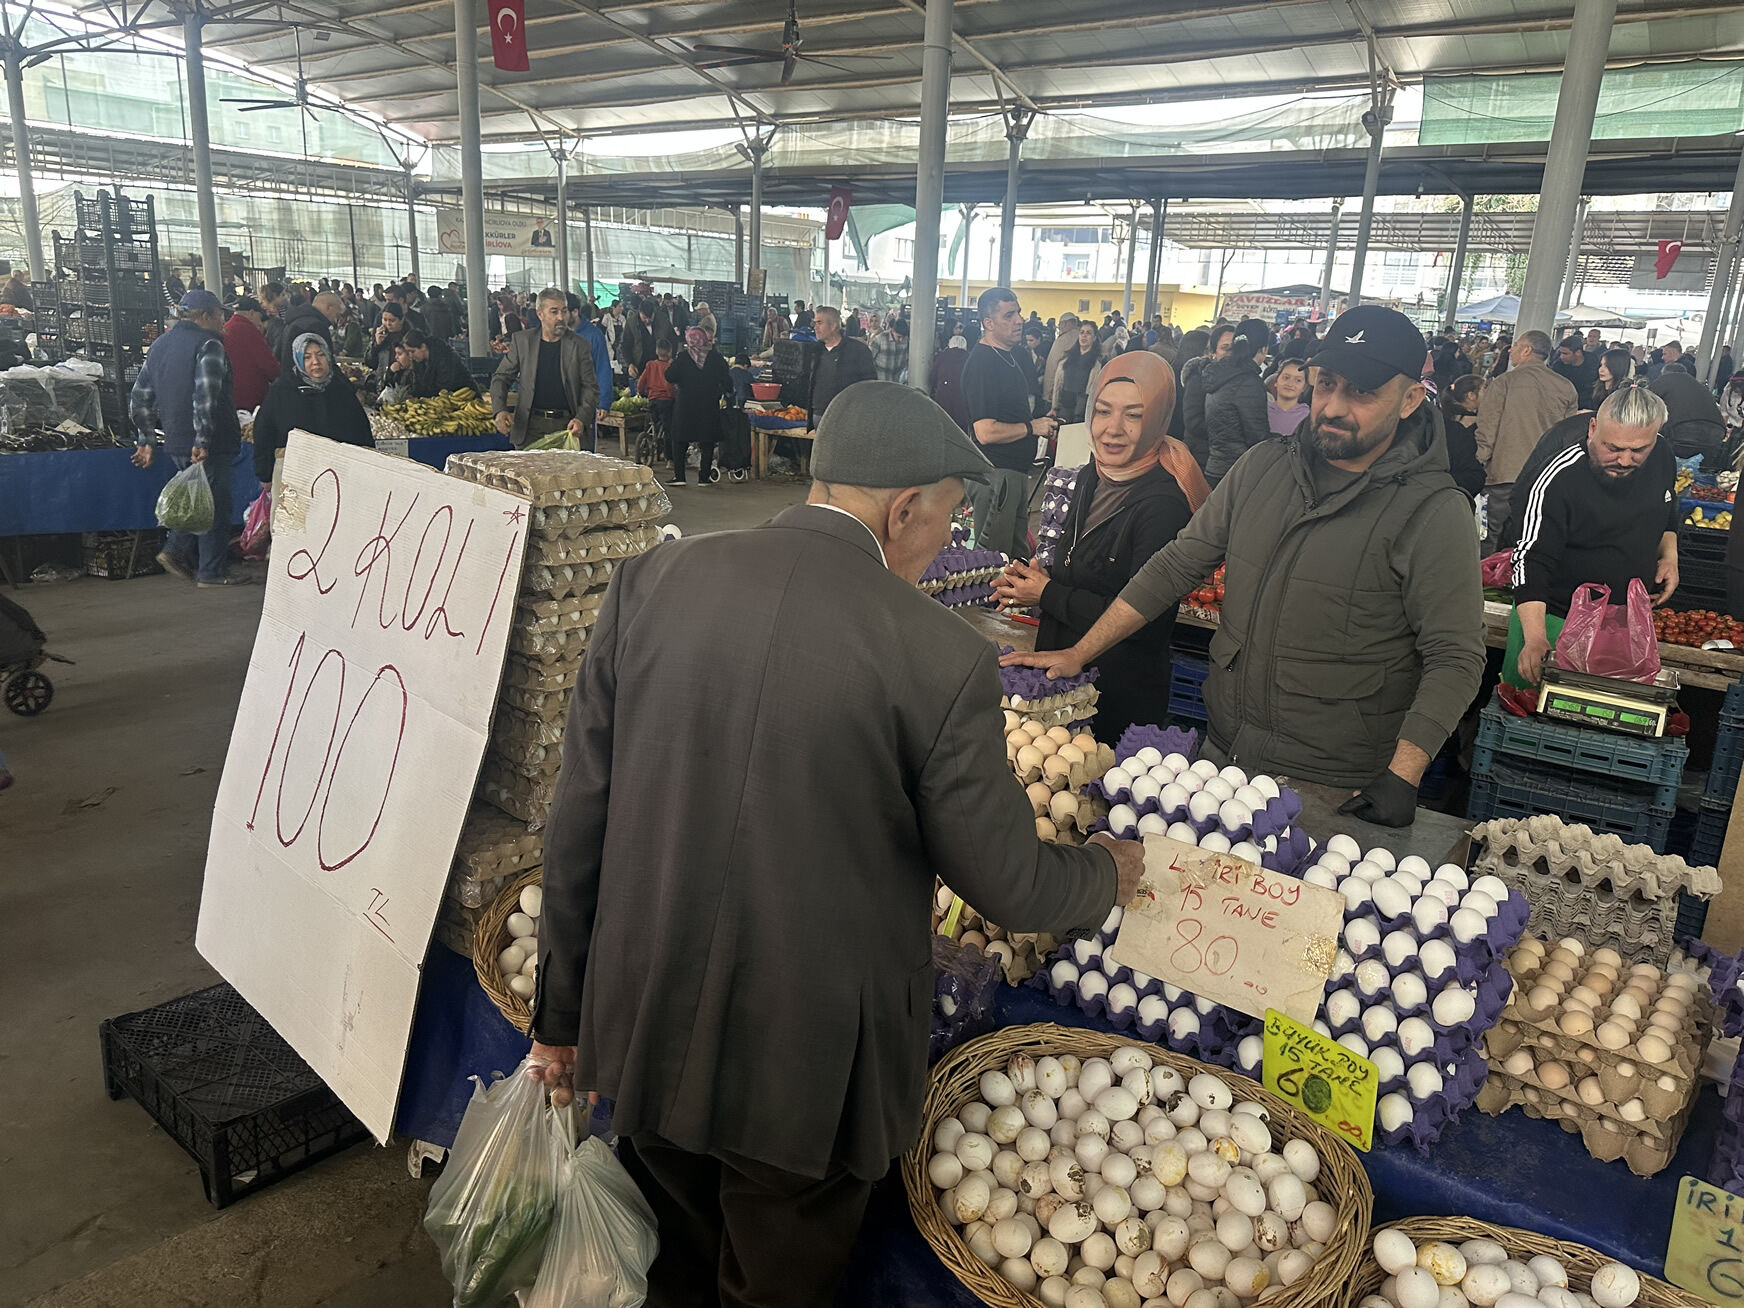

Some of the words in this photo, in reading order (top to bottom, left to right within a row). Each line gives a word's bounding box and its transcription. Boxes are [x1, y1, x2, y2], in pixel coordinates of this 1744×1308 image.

[485, 230, 516, 240] KKÜRLER
[485, 240, 513, 249] İRLİOVA
[1228, 295, 1305, 306] YAVUZLAR
[287, 467, 341, 594] 2
[246, 631, 408, 871] 100
[367, 887, 392, 927] TL
[1180, 883, 1208, 912] 15
[1221, 896, 1280, 929] TANE
[1250, 873, 1301, 906] BOY
[1265, 1016, 1331, 1062] BÜYÜK
[1279, 1041, 1305, 1063] 15
[1308, 1059, 1363, 1097] TANE
